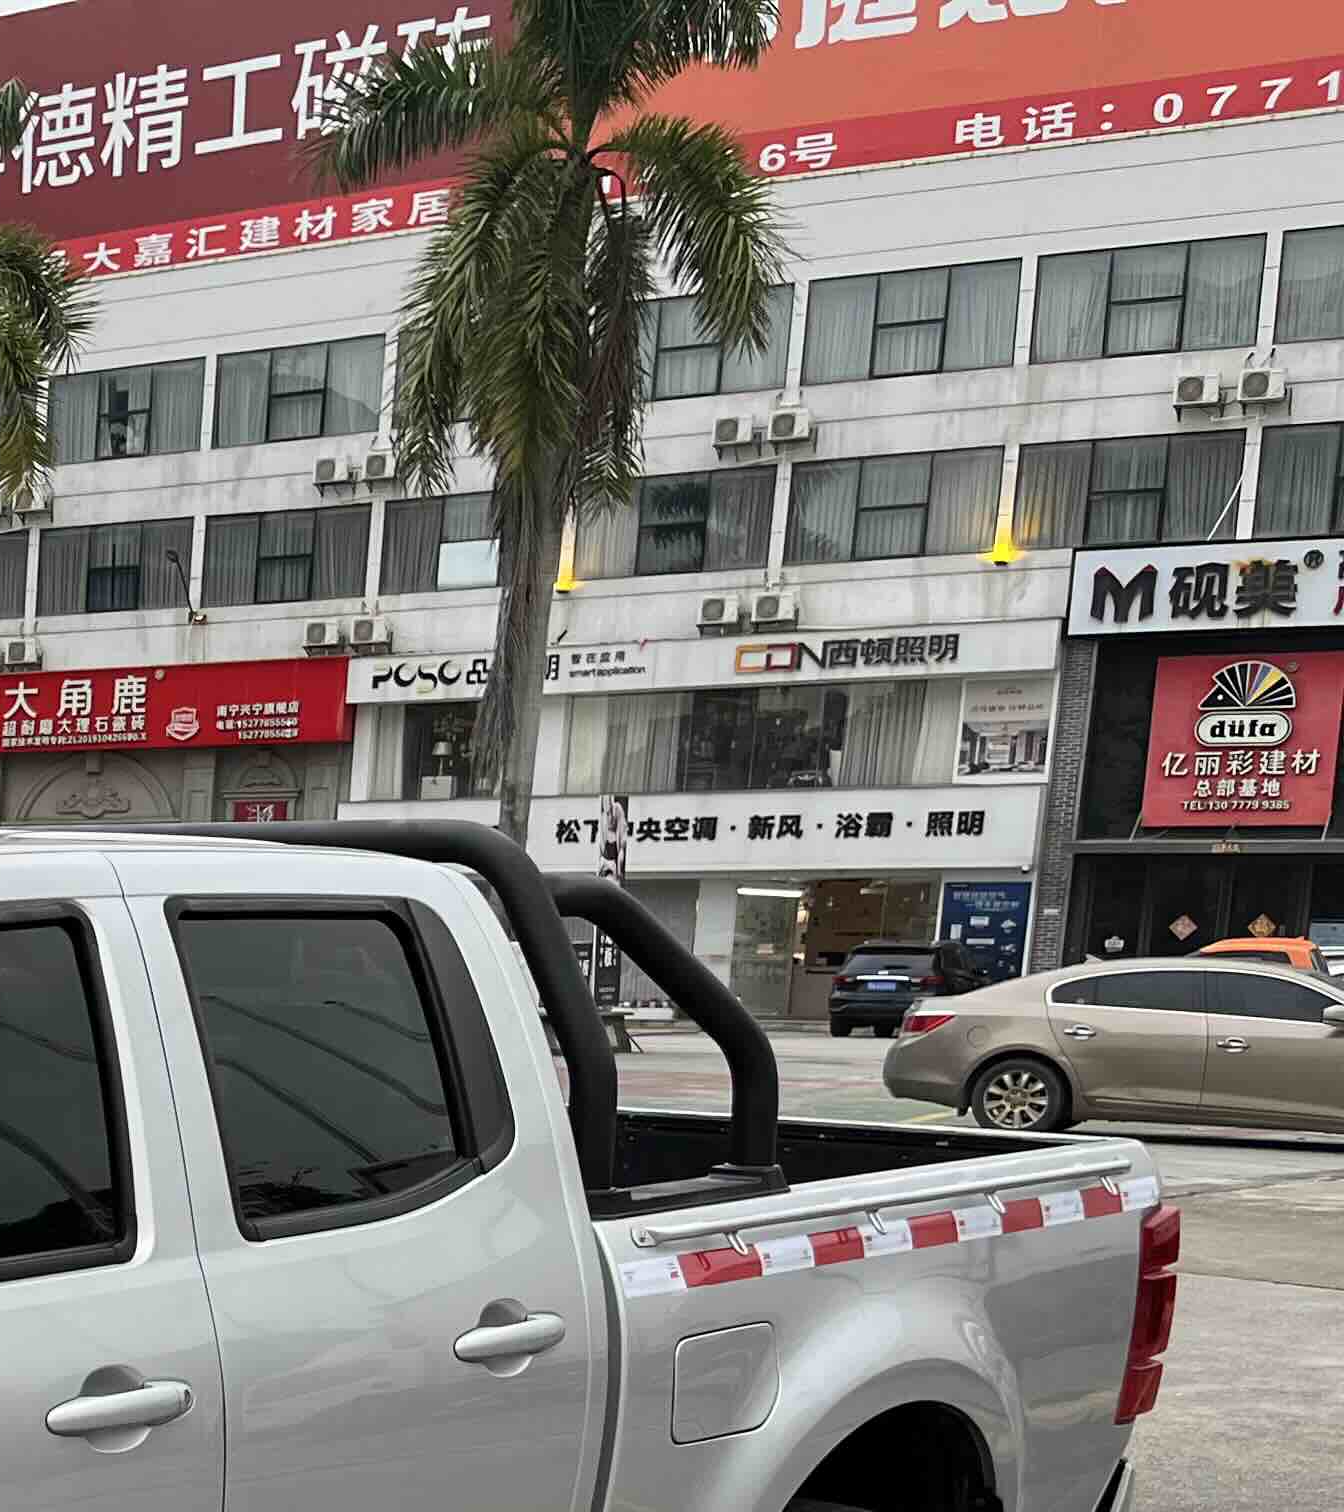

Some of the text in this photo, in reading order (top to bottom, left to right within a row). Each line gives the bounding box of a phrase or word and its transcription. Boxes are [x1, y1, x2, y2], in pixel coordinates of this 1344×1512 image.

[3, 675, 147, 719] 大角鹿
[1161, 748, 1321, 777] 亿丽彩建材
[1193, 778, 1281, 797] 总部基地
